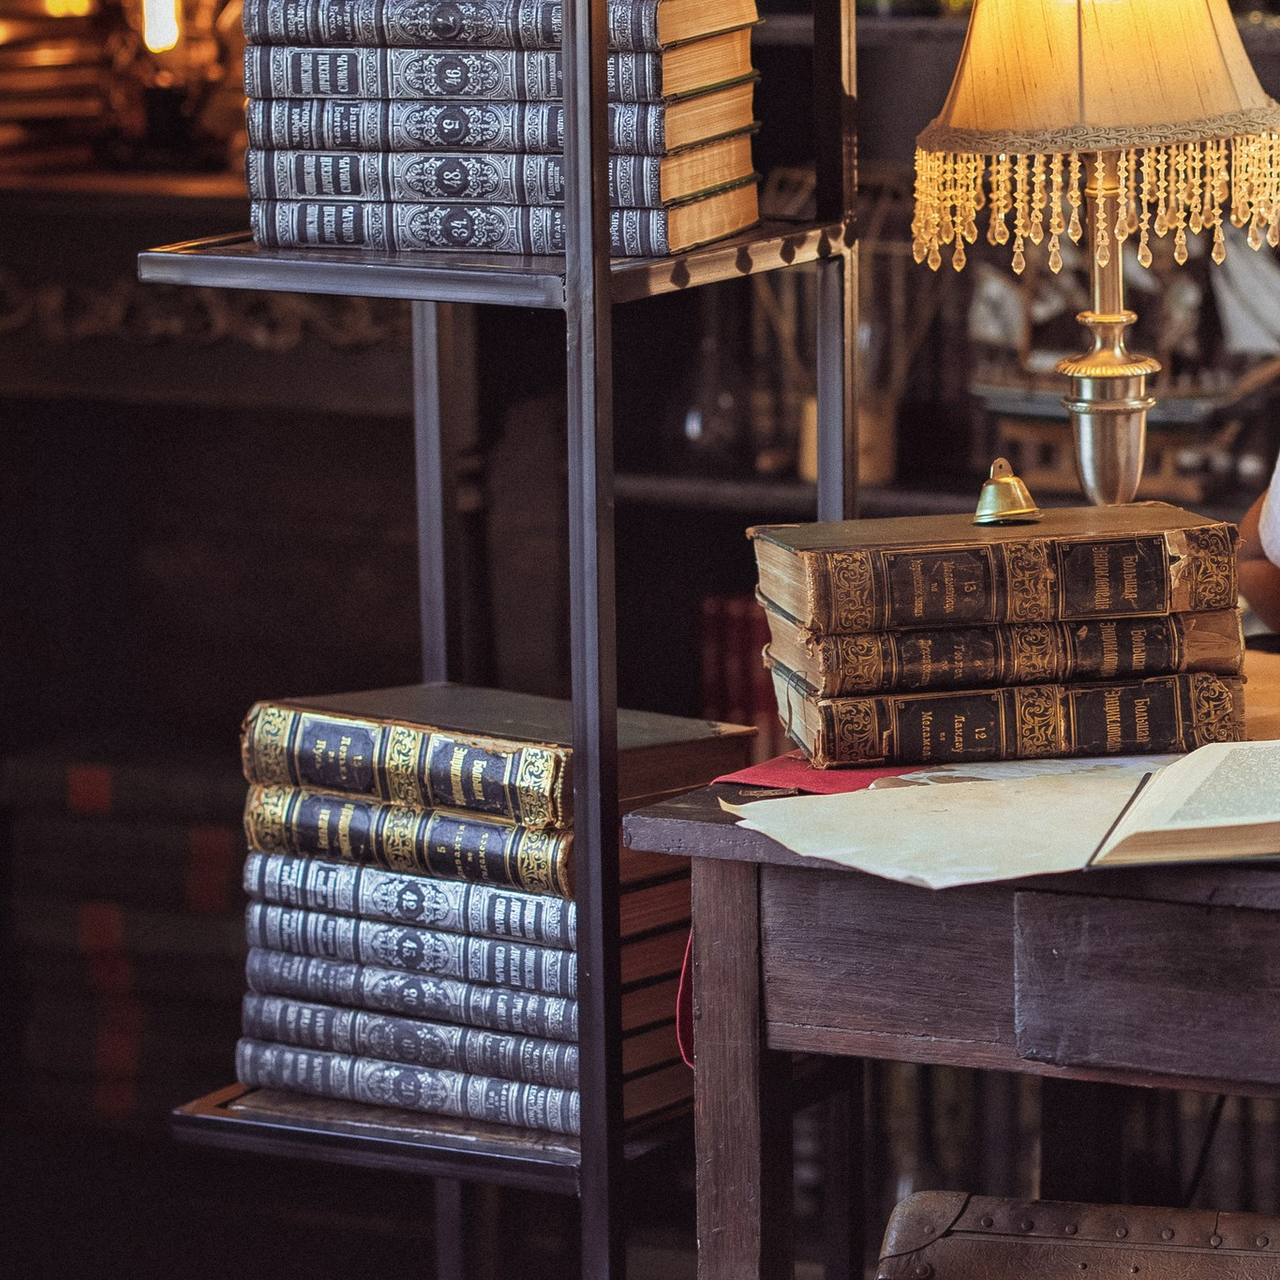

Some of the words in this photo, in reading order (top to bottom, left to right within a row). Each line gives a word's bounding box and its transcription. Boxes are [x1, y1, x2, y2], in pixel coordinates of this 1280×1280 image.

[336, 54, 349, 92] СЛОВАРЬ
[349, 107, 359, 143] Банки
[339, 156, 351, 193] СЛОВАРЬ
[342, 206, 354, 242] СЛОВАРЬ
[1092, 546, 1110, 610] Энциклопедія
[1122, 555, 1138, 600] Большая
[1131, 629, 1147, 670] Большая
[951, 714, 966, 754] Ландау
[974, 727, 987, 740] 12
[1104, 691, 1122, 752] Энциклопедія
[1134, 697, 1151, 743] Большая
[494, 898, 506, 935] СЛОВАРЬ
[494, 946, 505, 983] СЛОВАРЬ
